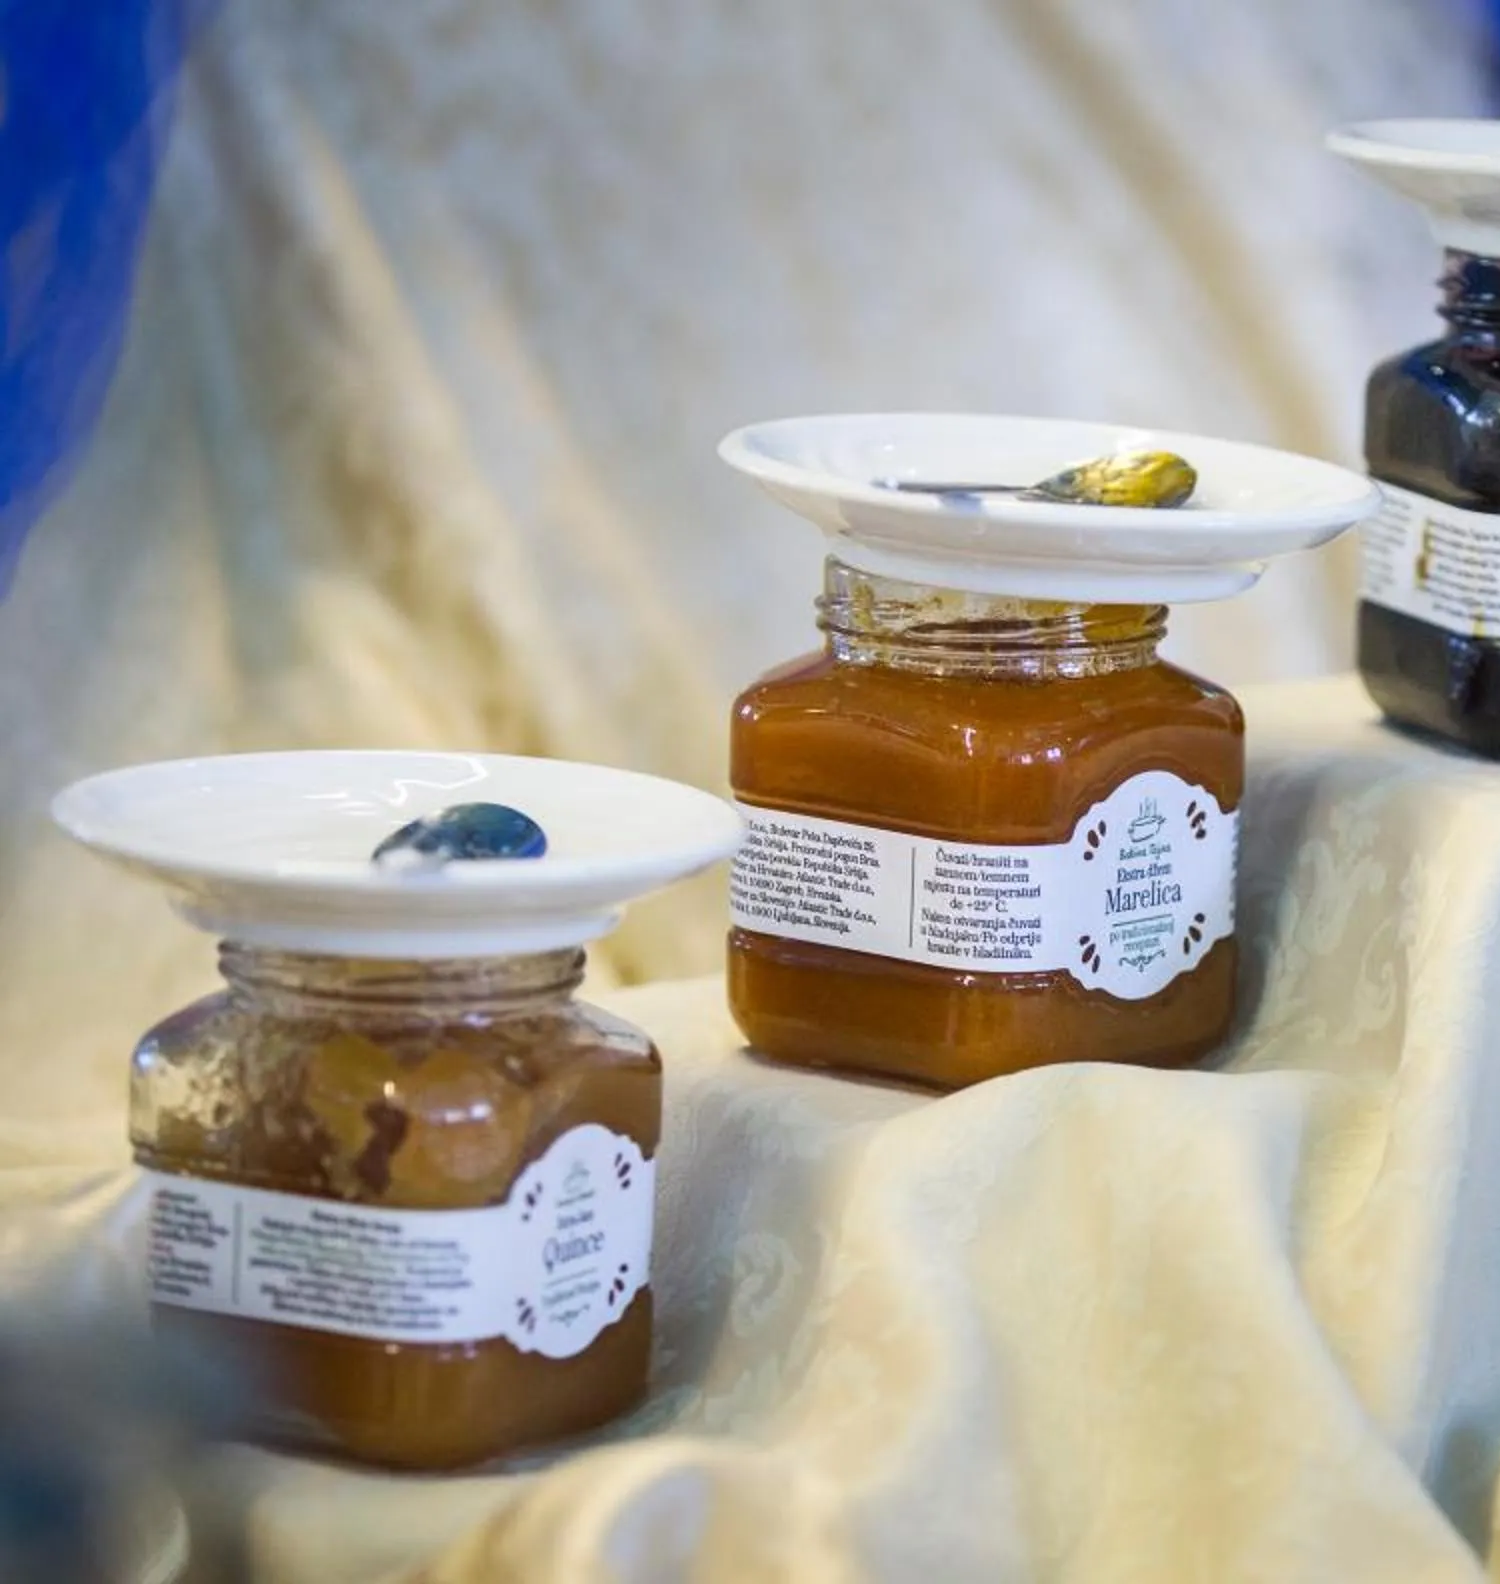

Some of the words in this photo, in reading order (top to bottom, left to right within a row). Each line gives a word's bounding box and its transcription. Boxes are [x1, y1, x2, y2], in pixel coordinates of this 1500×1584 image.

[949, 896, 963, 910] do
[957, 885, 971, 896] na
[1105, 879, 1183, 915] Marelica
[543, 1230, 605, 1274] Quince
